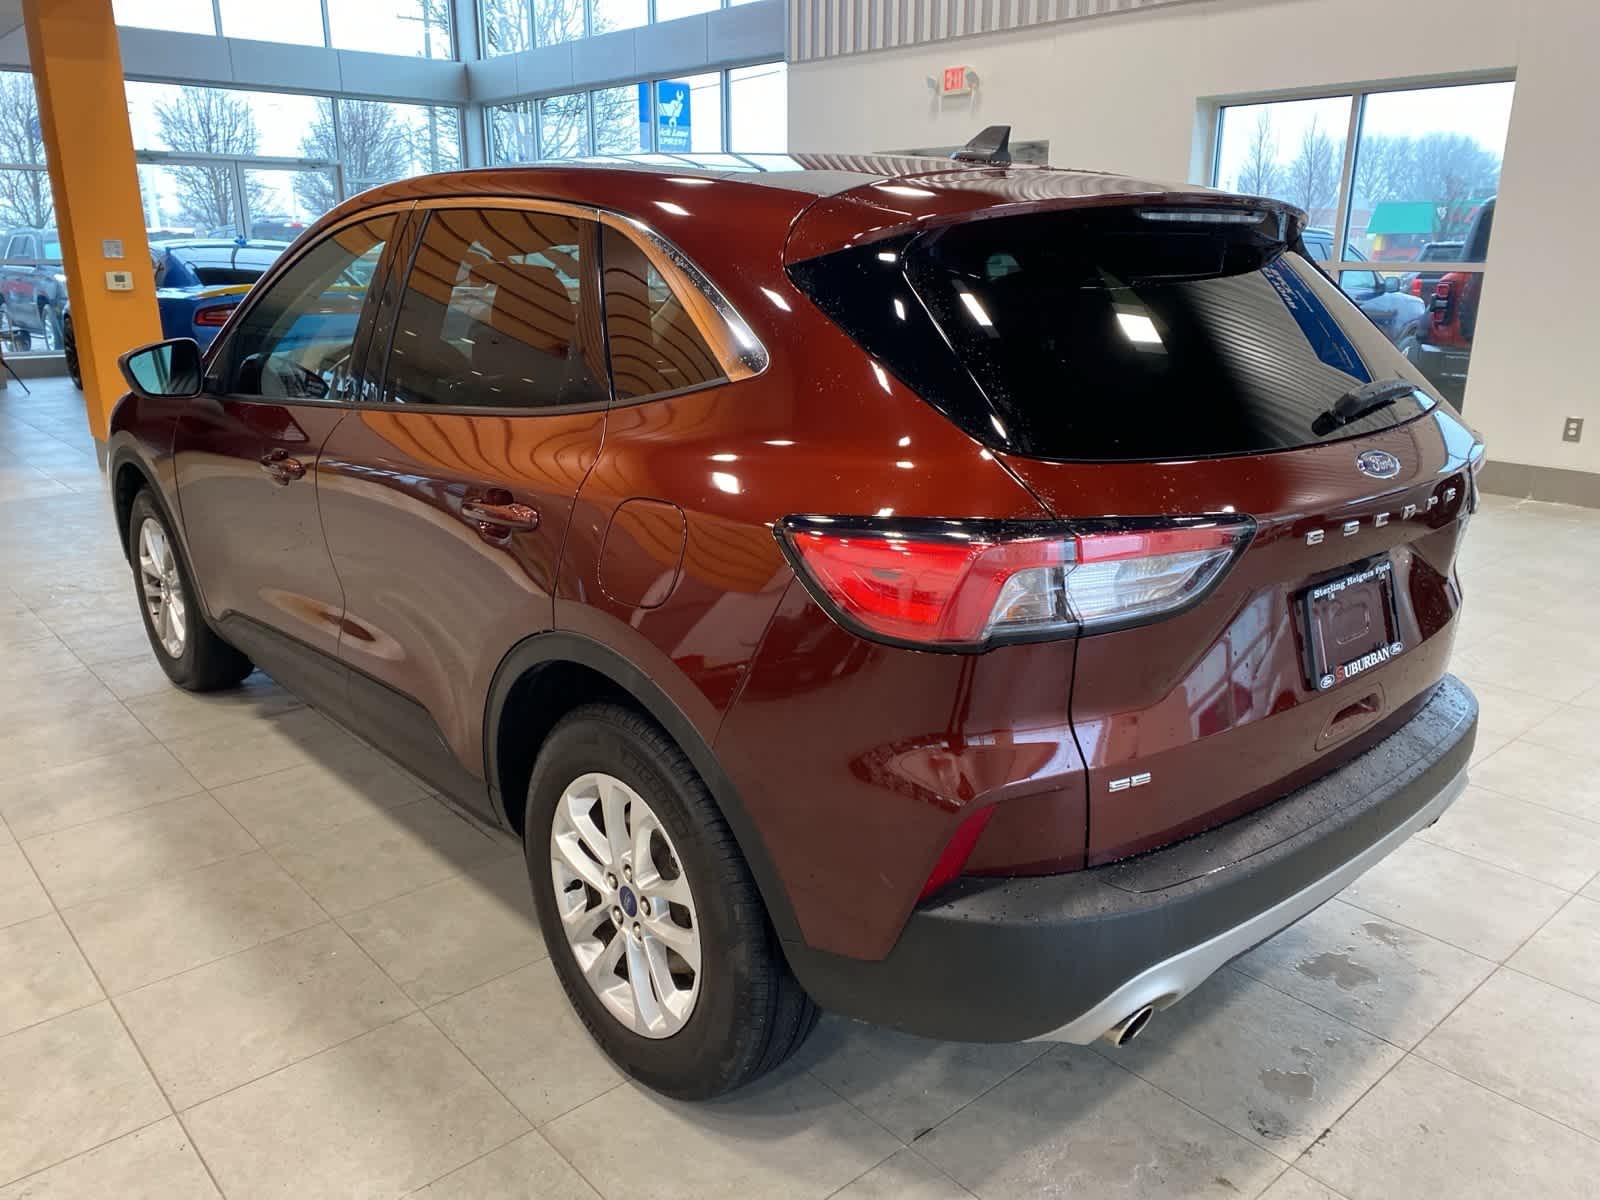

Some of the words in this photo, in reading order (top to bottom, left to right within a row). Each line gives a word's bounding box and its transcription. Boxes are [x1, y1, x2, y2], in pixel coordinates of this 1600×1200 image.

[1306, 488, 1456, 546] ESCAPE
[1313, 581, 1346, 599] Sterling
[1335, 646, 1391, 682] SUBURBAN
[1108, 772, 1152, 793] SE
